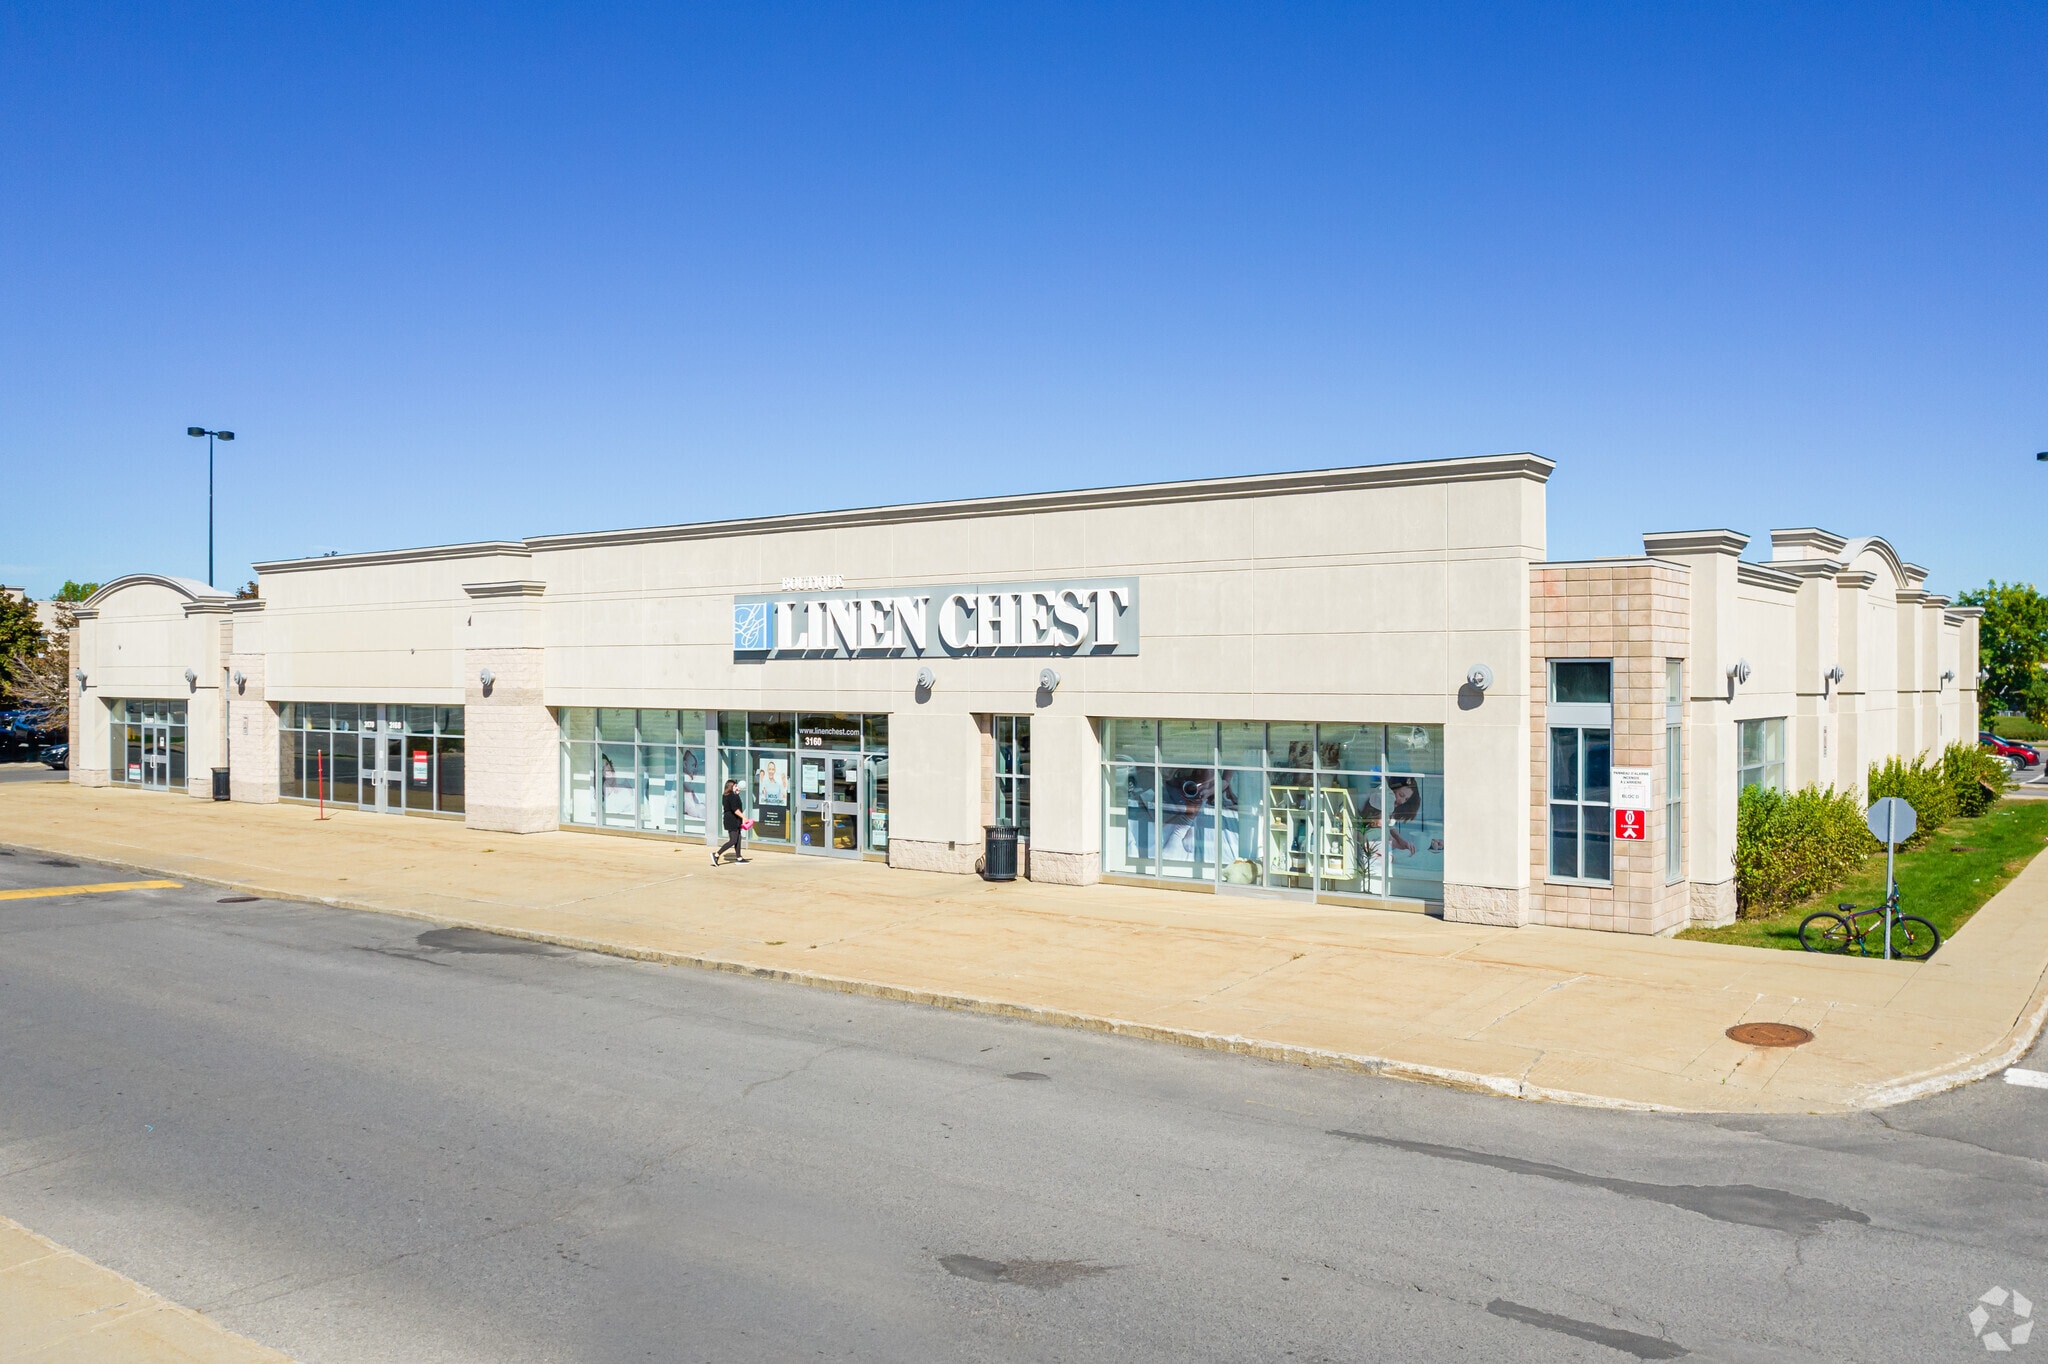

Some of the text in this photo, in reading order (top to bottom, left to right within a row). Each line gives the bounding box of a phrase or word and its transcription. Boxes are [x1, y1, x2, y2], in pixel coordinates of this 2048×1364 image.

[781, 575, 844, 592] BOUTIQUE
[774, 587, 1129, 650] LINEN CHEST
[799, 727, 860, 736] www.linenchest.com
[804, 736, 822, 746] 3160
